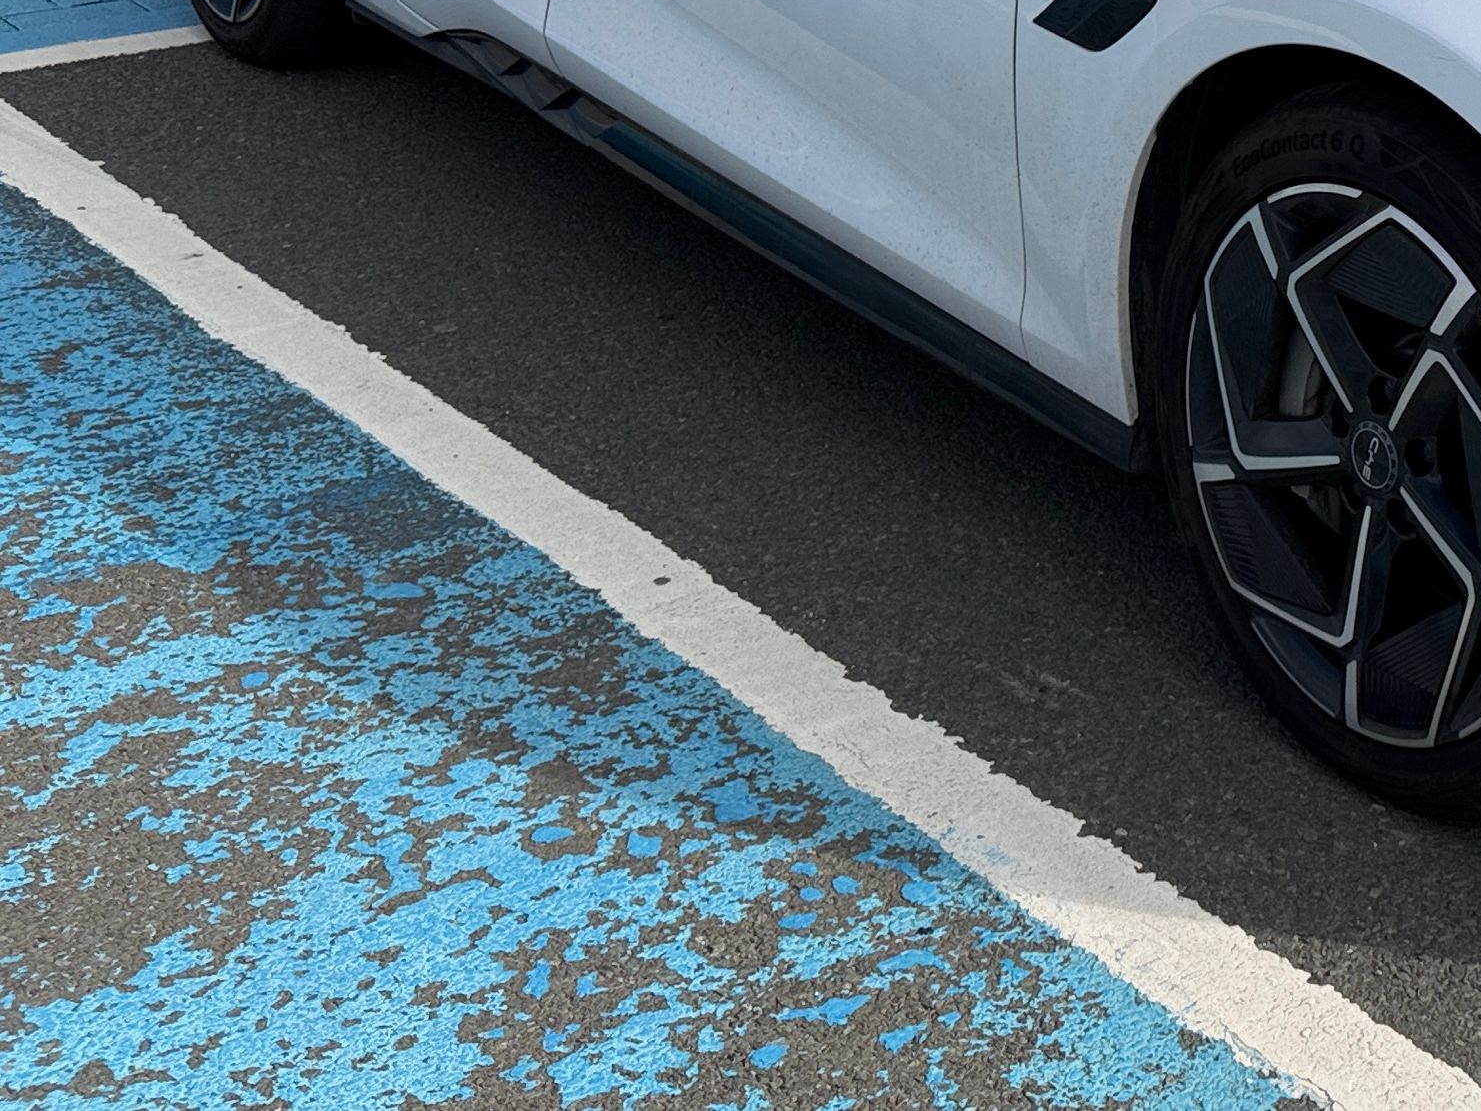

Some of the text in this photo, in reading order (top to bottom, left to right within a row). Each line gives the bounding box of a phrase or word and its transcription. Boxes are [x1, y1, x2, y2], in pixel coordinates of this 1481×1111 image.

[1232, 129, 1365, 179] EcoContact 6 Q
[1362, 437, 1380, 481] BYD
